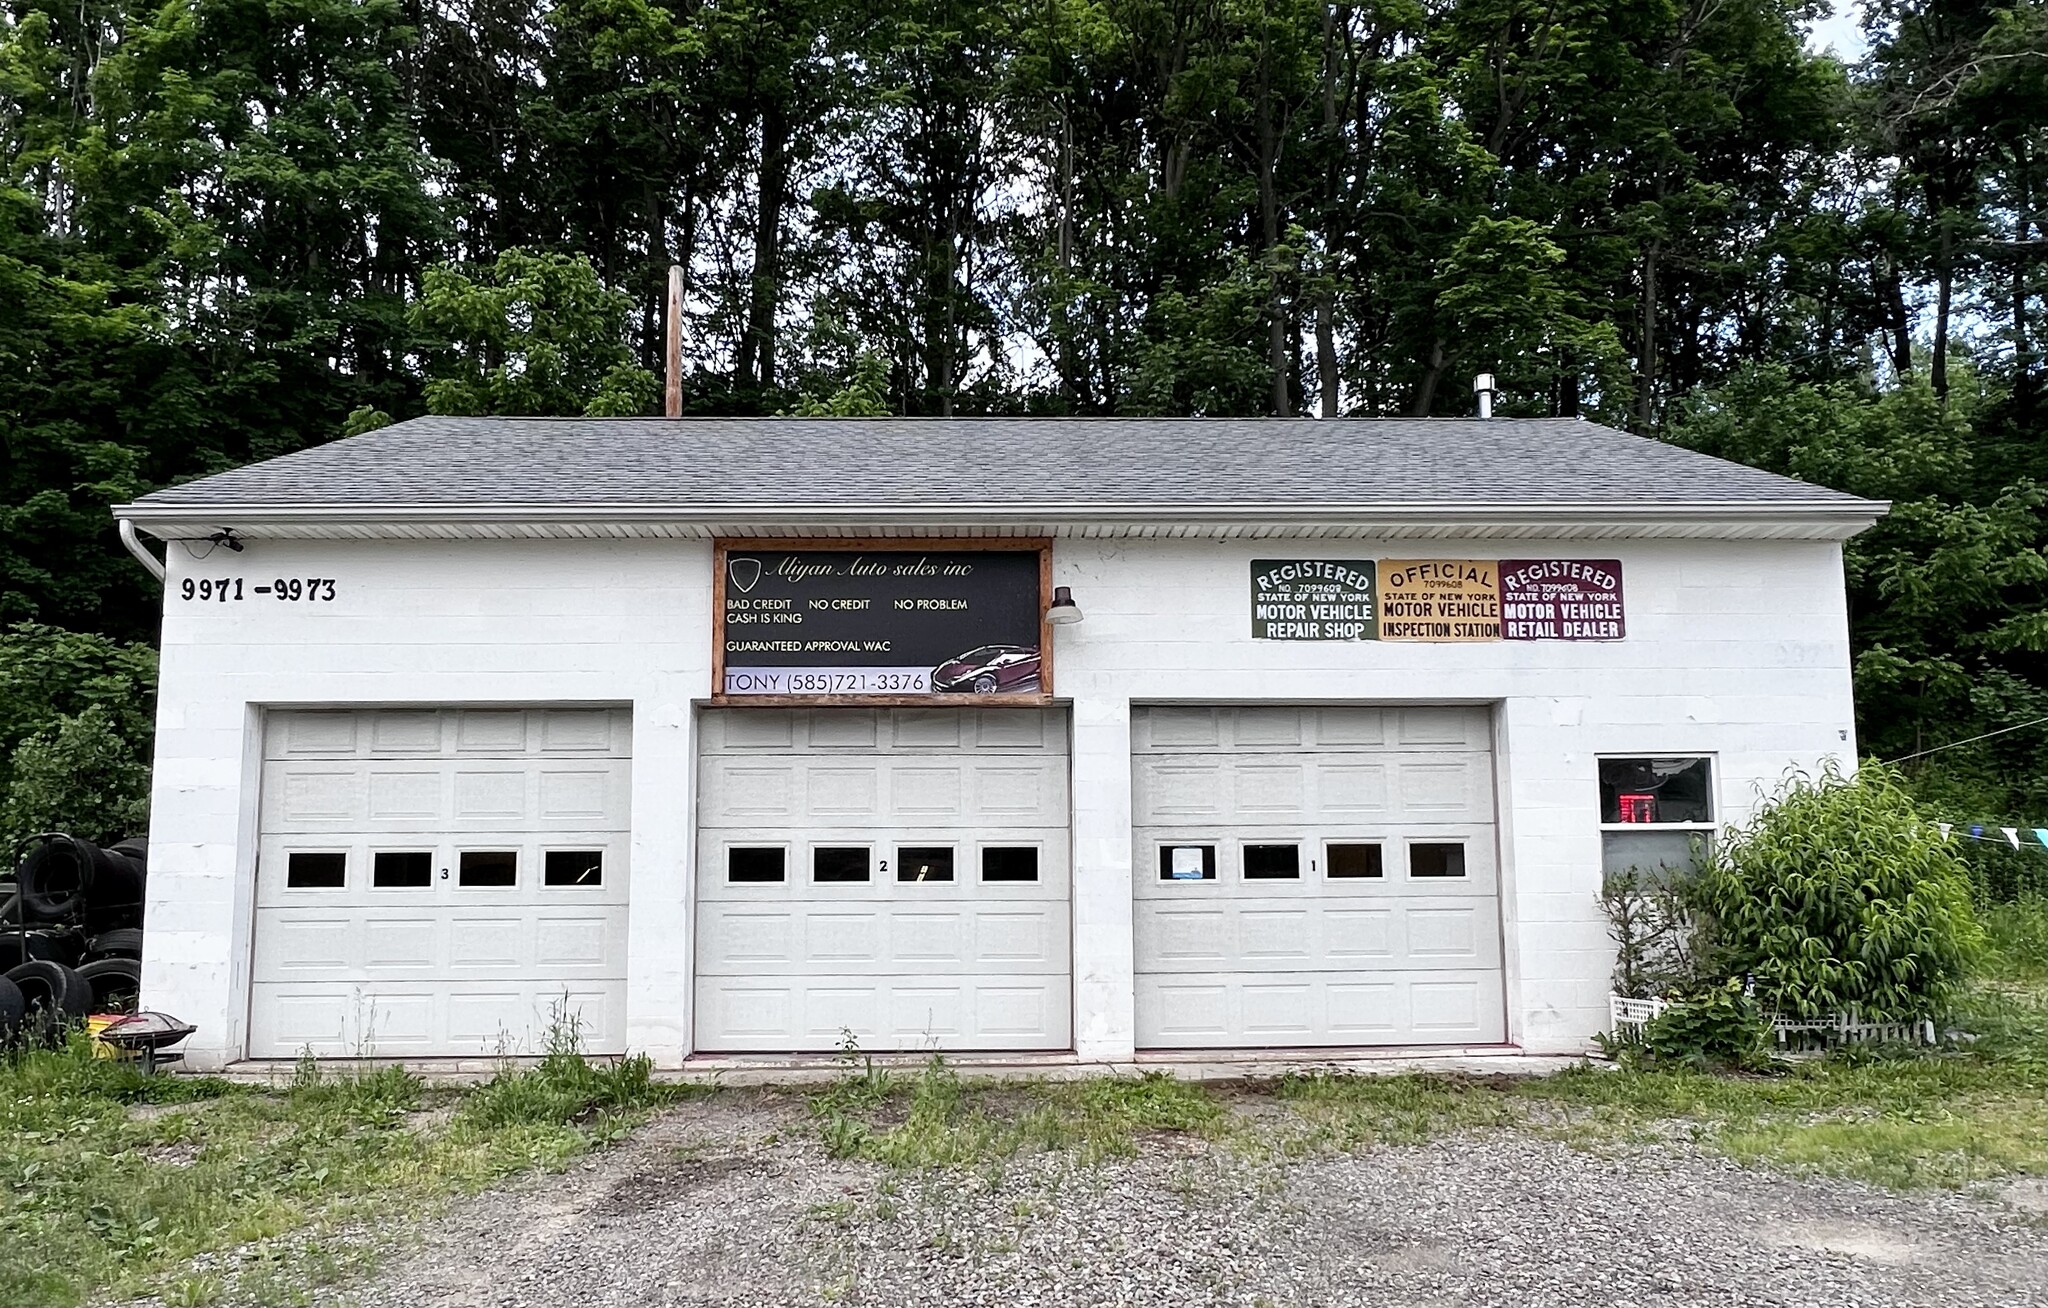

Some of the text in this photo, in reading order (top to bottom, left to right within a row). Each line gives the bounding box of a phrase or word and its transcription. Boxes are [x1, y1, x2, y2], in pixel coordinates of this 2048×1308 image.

[837, 556, 888, 576] Auto
[893, 557, 941, 576] sales
[943, 561, 973, 576] inc
[1256, 561, 1369, 592] REGISTERED
[1390, 563, 1492, 588] OFFICIAL
[1504, 561, 1616, 591] REGISTERED
[1257, 593, 1370, 602] STATE OF NEW YORK
[1384, 593, 1496, 601] STATE OF NEW YORK
[1505, 592, 1617, 601] STATE OF NEW YORK
[727, 599, 793, 610] BAD CREDIT
[808, 599, 871, 610] NO CREDIT
[894, 599, 968, 610] NO PROBLEM
[1384, 602, 1498, 617] MOTOR VEHICLE
[1504, 603, 1621, 619] MOTOR VEHICLE
[726, 613, 803, 624] CASH IS KING
[1256, 604, 1373, 620] MOTOR VEHICLE
[1266, 622, 1365, 638] REPAIR SHOP
[1383, 622, 1500, 637] INSPECTION STATION
[1507, 621, 1619, 637] RETAIL DEALER
[726, 641, 891, 652] GUARANTEED APPROVAL WAC
[726, 674, 924, 693] TONY (585)721-3376
[879, 860, 888, 872] 2
[1311, 860, 1316, 872] 1
[441, 868, 450, 881] 3
